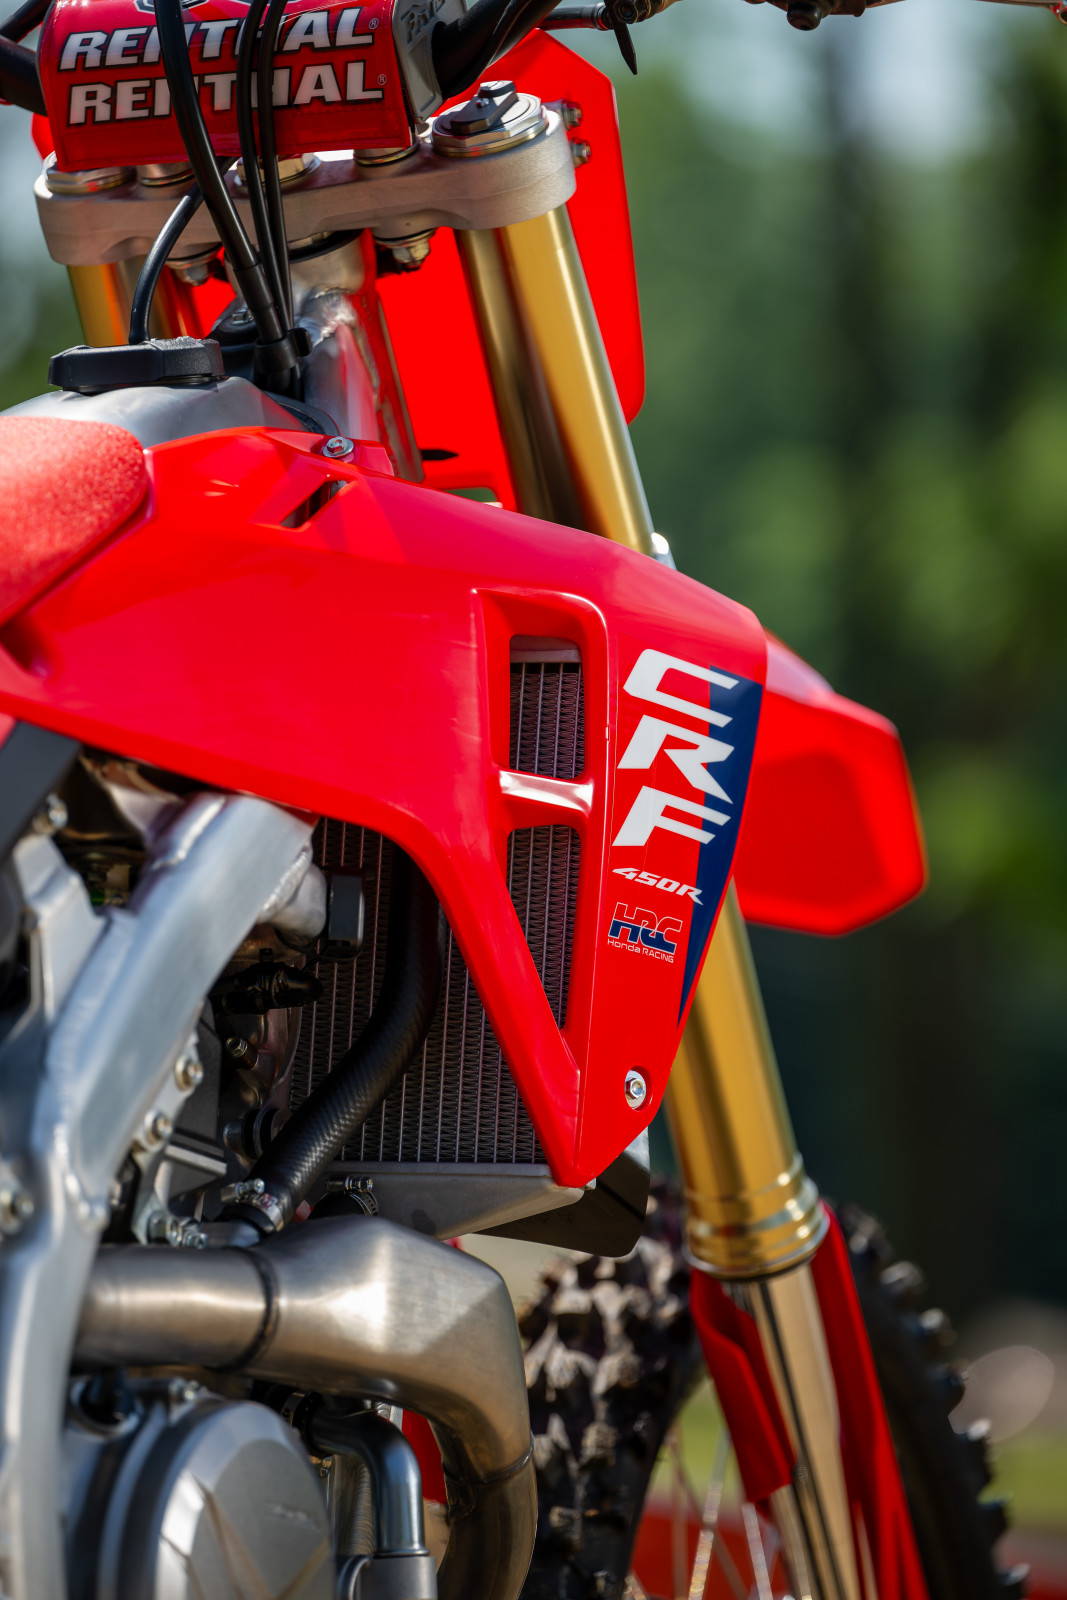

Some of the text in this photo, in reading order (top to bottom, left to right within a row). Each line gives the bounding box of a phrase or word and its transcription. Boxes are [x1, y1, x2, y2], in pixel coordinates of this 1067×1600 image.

[611, 649, 740, 847] CRF
[612, 867, 704, 906] 450R
[607, 938, 675, 964] Honda RACING
[608, 902, 683, 955] HRC
